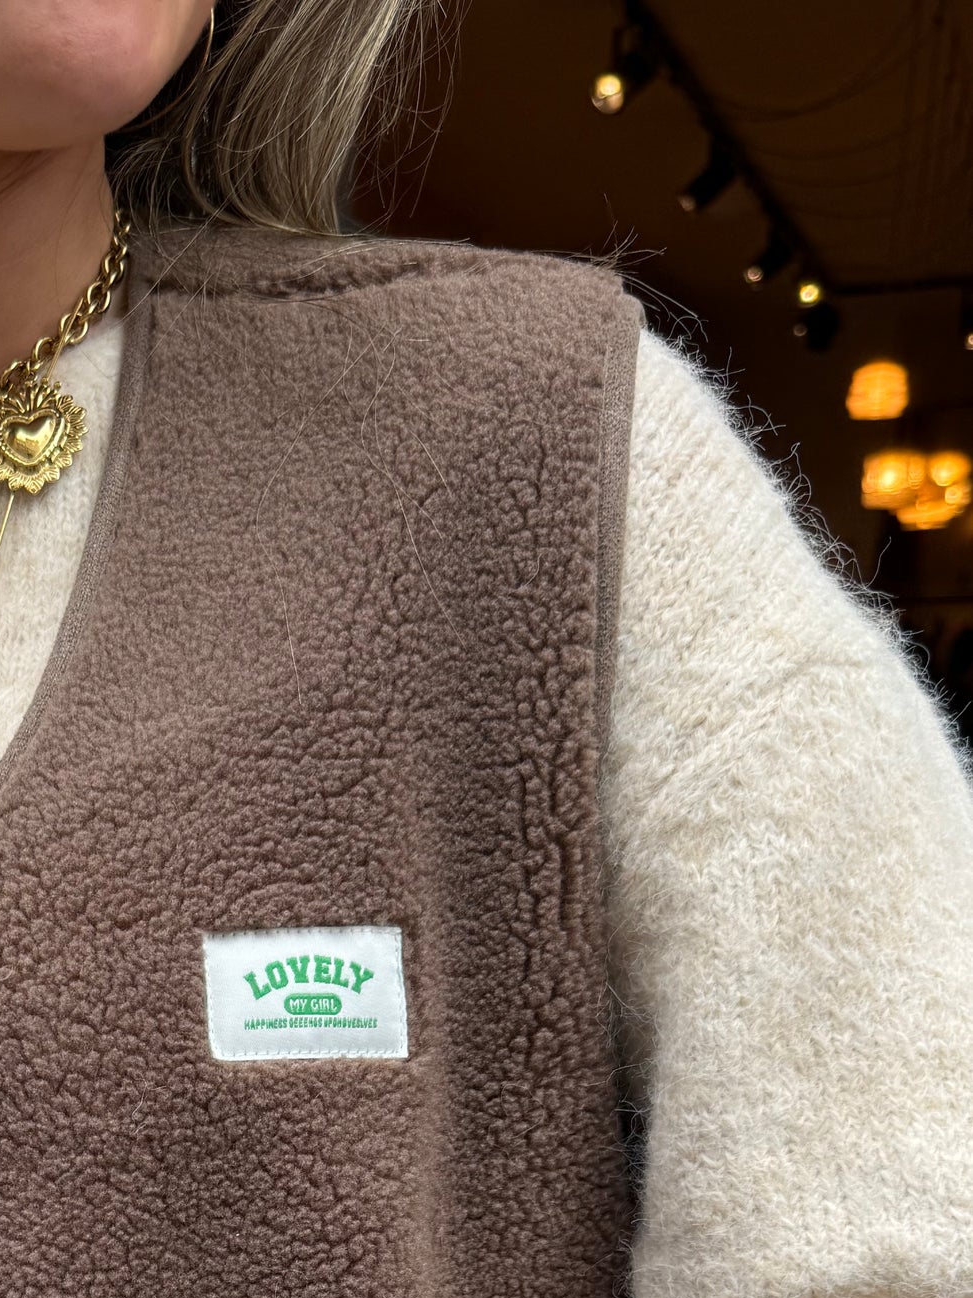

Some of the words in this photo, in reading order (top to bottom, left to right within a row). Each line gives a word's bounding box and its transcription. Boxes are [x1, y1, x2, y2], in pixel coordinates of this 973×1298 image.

[243, 954, 375, 1000] LOVELY
[289, 998, 307, 1011] MY
[310, 998, 338, 1011] GIRL
[244, 1018, 288, 1031] HAPPINESS
